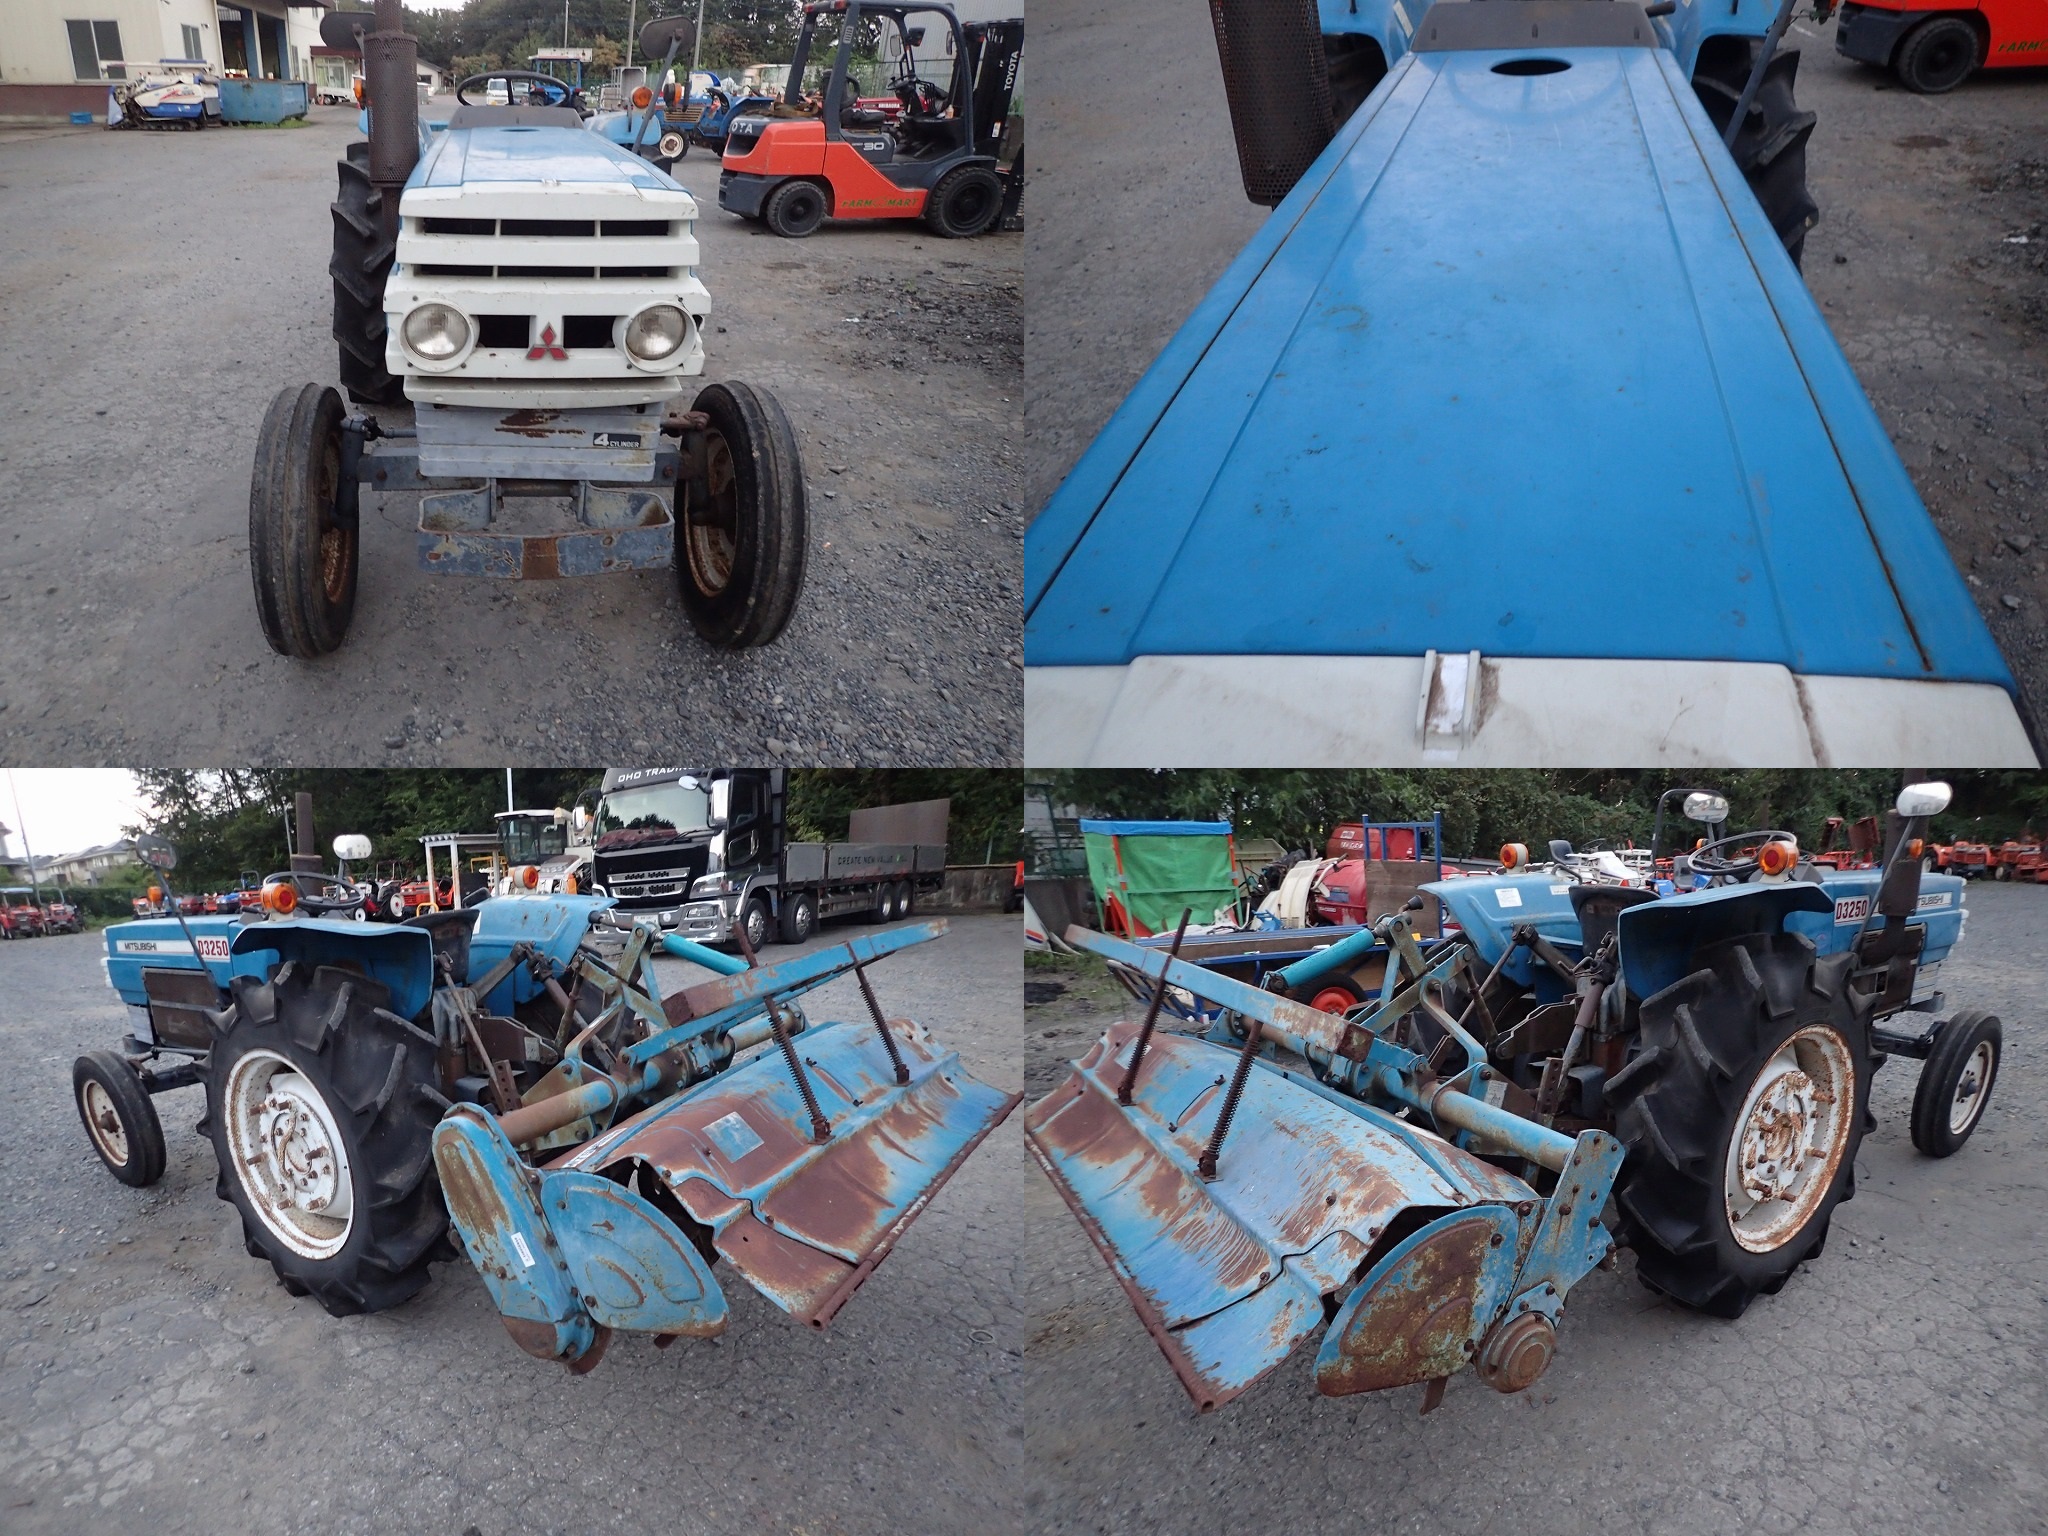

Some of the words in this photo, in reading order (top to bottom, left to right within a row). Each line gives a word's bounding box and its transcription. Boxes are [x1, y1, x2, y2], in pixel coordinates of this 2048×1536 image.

[1003, 50, 1019, 91] TOYOTA
[863, 142, 885, 151] 30
[841, 199, 872, 208] FARM
[886, 198, 919, 207] MART
[593, 432, 609, 446] 4
[609, 440, 640, 448] CYLINDER
[645, 767, 695, 777] TRAD
[838, 855, 861, 866] CREATE
[1835, 899, 1867, 920] D3250
[124, 942, 157, 951] MITSUBISHI
[197, 940, 229, 957] D3250
